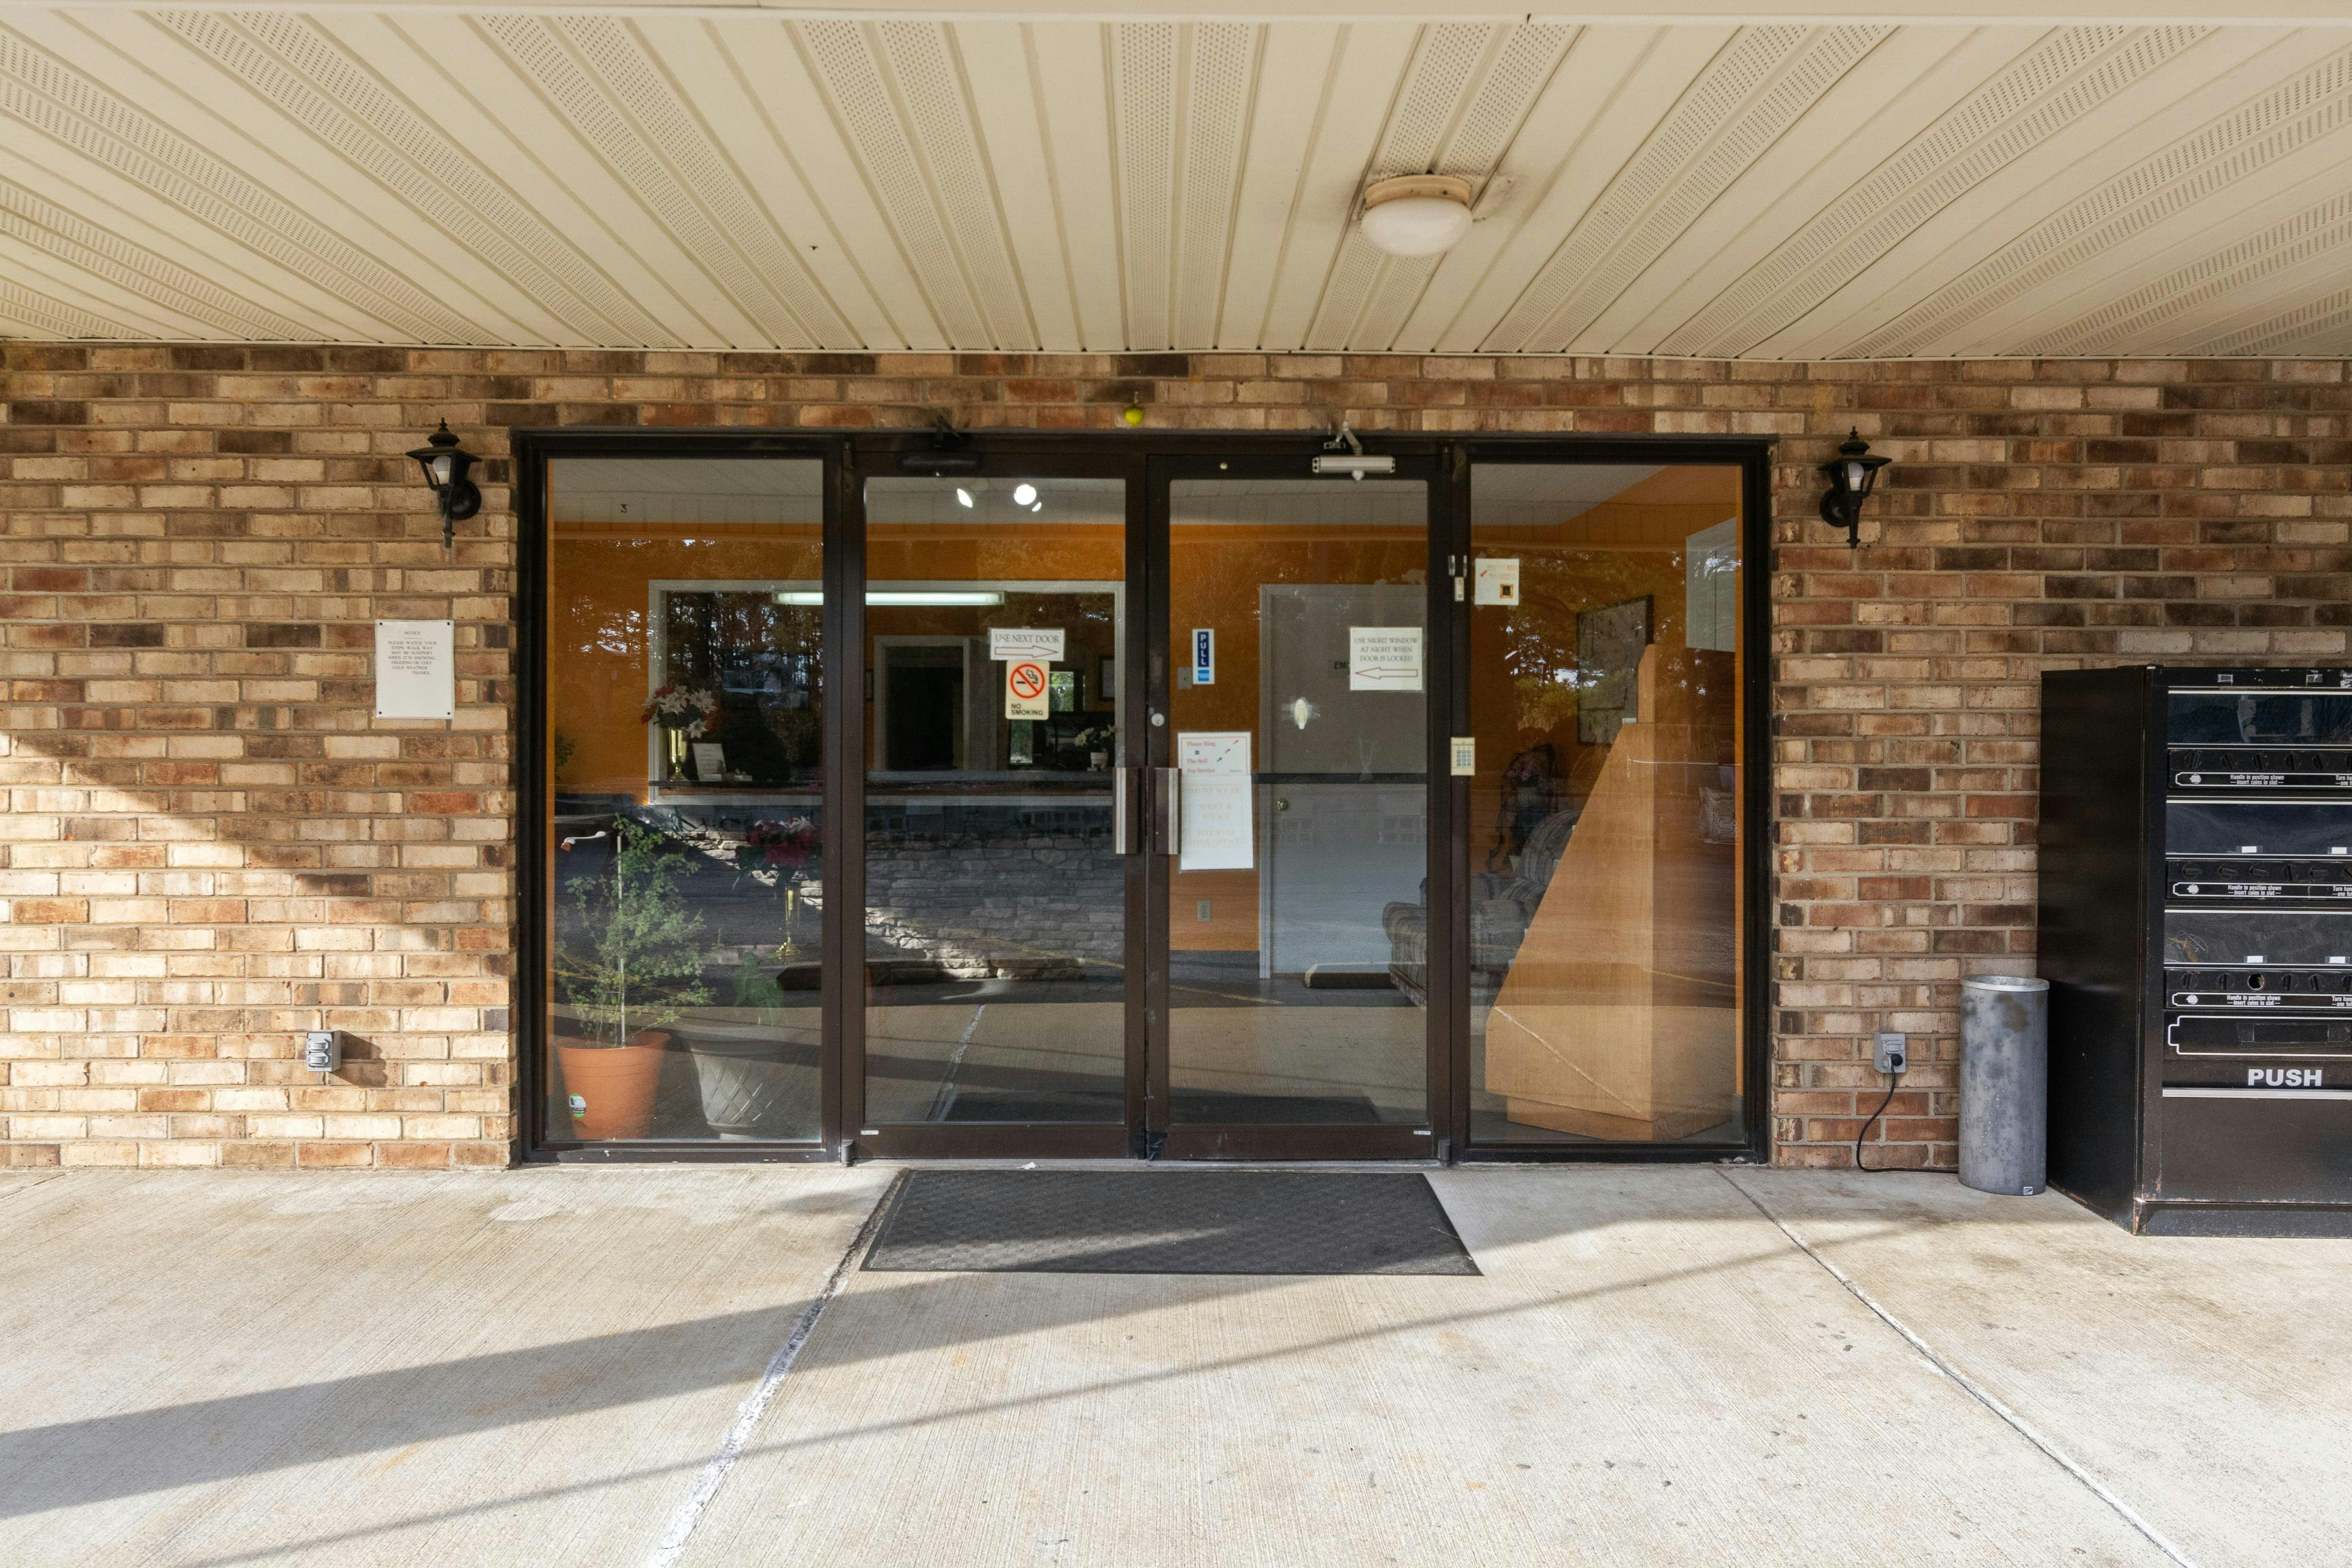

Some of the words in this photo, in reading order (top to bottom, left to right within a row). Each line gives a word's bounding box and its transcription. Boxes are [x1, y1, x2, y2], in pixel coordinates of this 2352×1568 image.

[995, 634, 1010, 642] USE
[1012, 634, 1034, 643] NEXT
[1035, 635, 1060, 643] DOOR
[2248, 1068, 2322, 1087] PUSH
